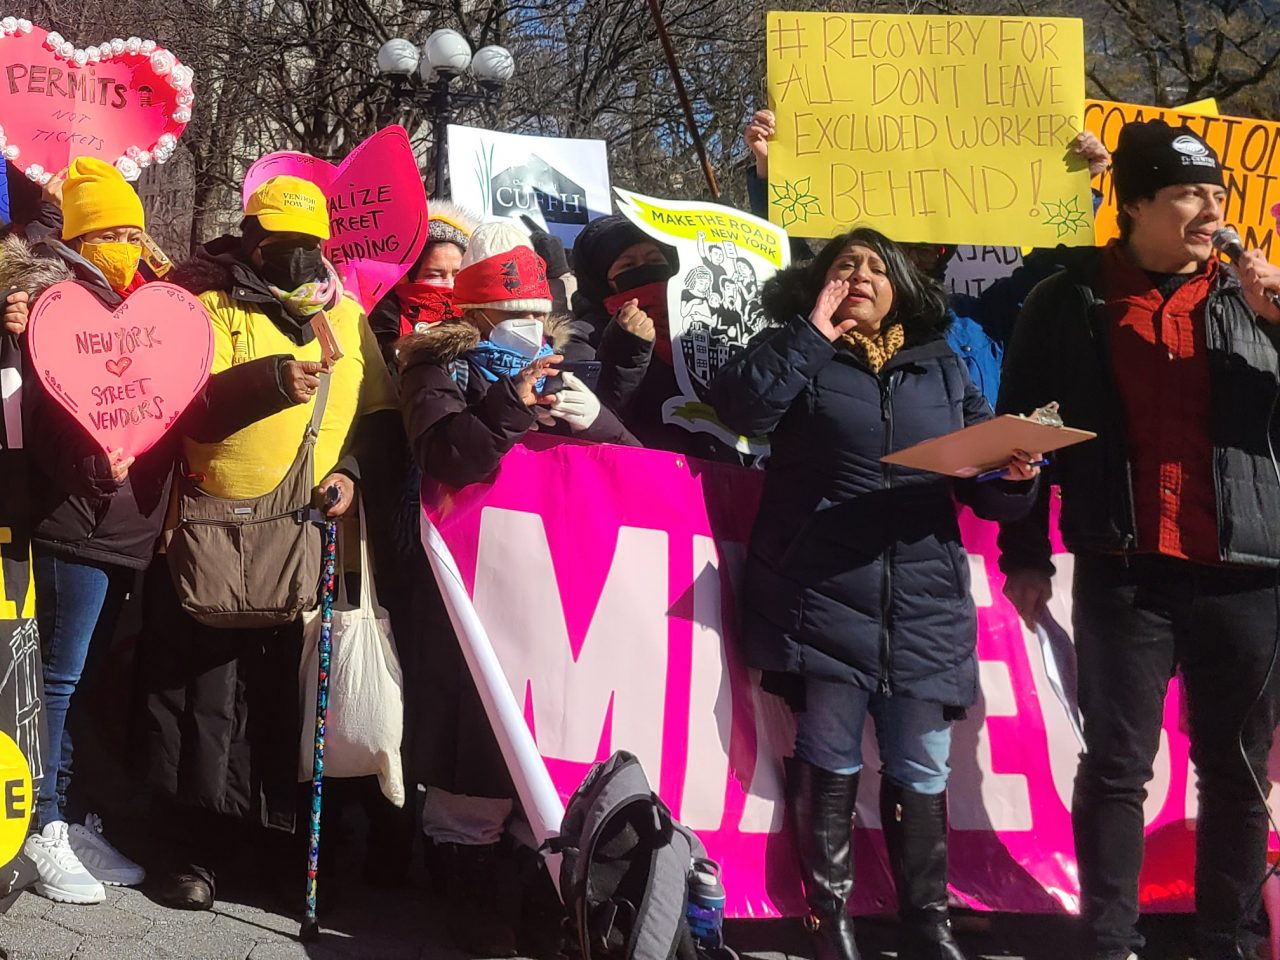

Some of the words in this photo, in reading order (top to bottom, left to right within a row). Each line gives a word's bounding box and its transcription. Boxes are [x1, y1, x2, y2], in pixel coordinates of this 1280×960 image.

[998, 20, 1060, 64] FOR
[776, 63, 855, 105] ALL
[983, 63, 1064, 108] LEAVE
[51, 109, 92, 123] NOT
[794, 111, 938, 158] EXCLUDED
[945, 113, 1080, 152] WORKERS
[652, 210, 696, 227] MAKE
[695, 215, 727, 227] THE
[728, 218, 777, 246] ROAD
[710, 228, 738, 240] NEW
[742, 235, 777, 259] YORK
[91, 377, 152, 407] STREET
[88, 395, 165, 432] VENDORS
